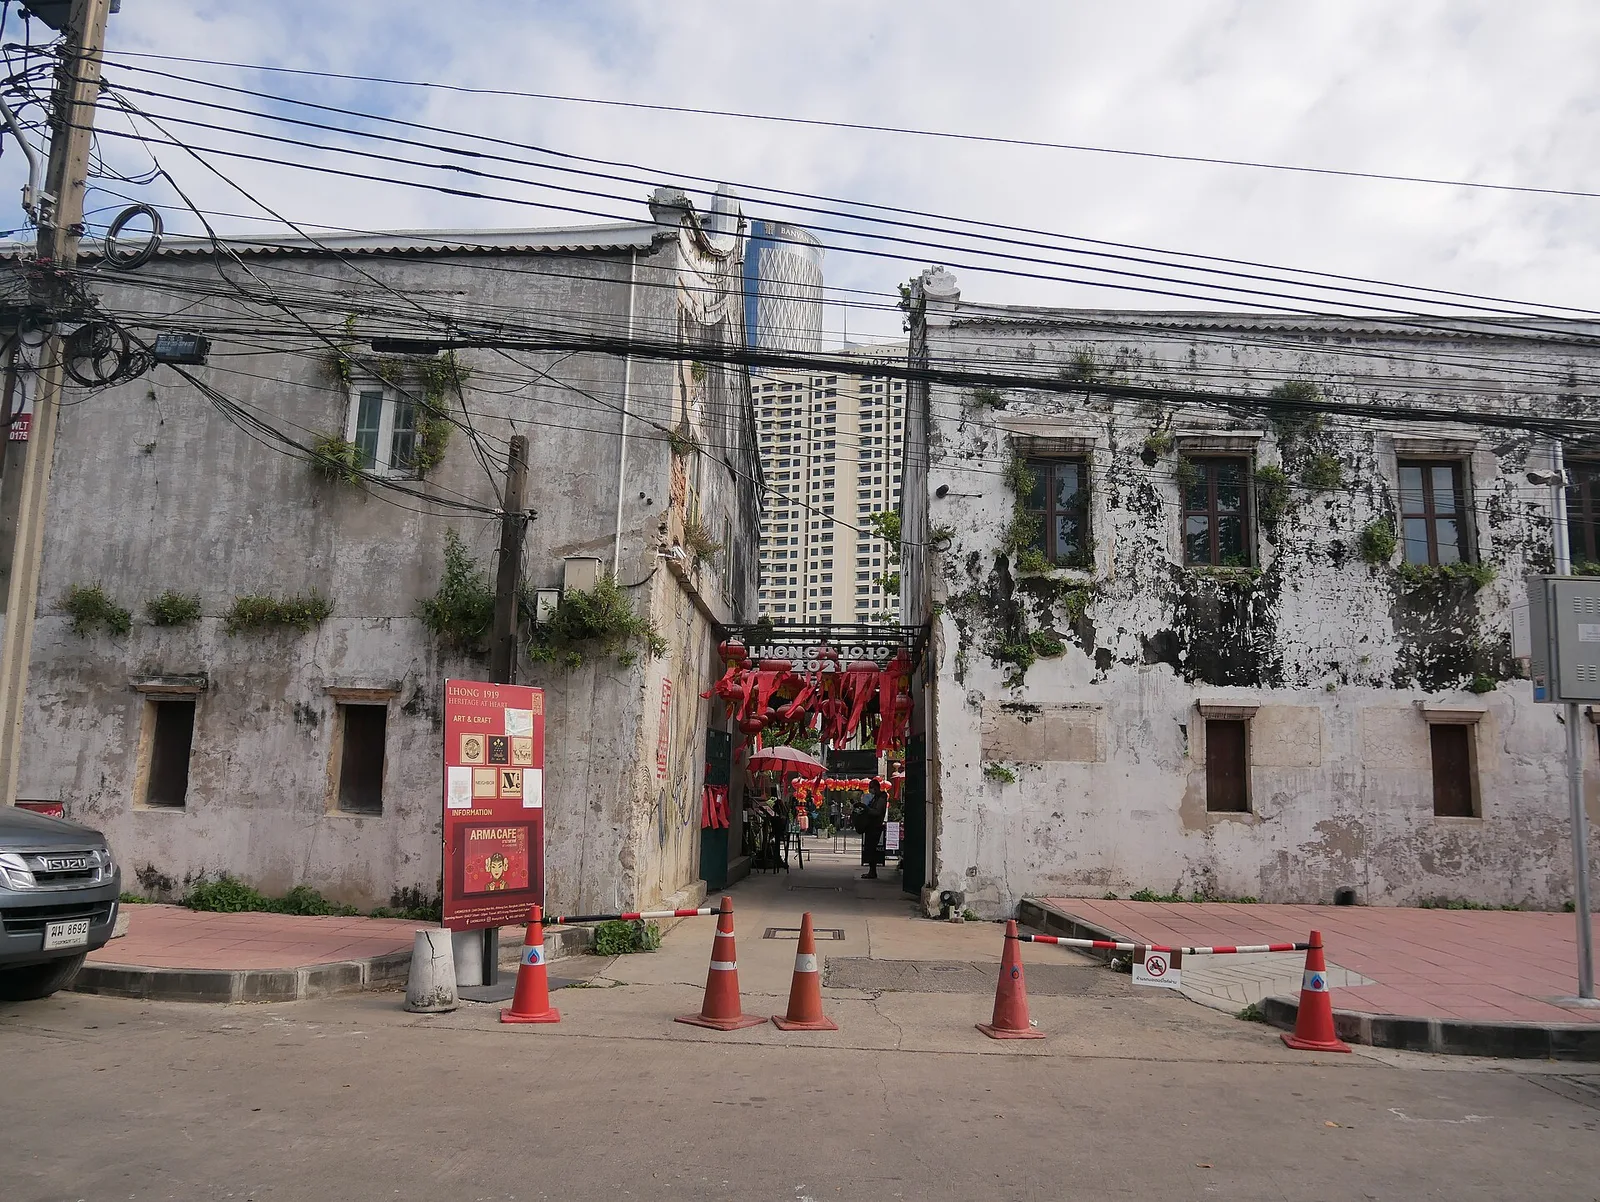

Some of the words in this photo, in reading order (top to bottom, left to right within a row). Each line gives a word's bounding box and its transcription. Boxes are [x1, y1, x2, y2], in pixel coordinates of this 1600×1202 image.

[12, 422, 29, 430] WLT
[9, 432, 28, 440] 0175
[749, 645, 819, 660] LHONG
[841, 646, 890, 660] 1919
[791, 660, 848, 673] 2021
[449, 687, 480, 698] LHONG
[484, 690, 500, 699] 1919
[448, 698, 479, 706] HERITAGE
[474, 716, 492, 724] CRAFT
[47, 858, 86, 870] ISUZU
[67, 922, 87, 936] 8692
